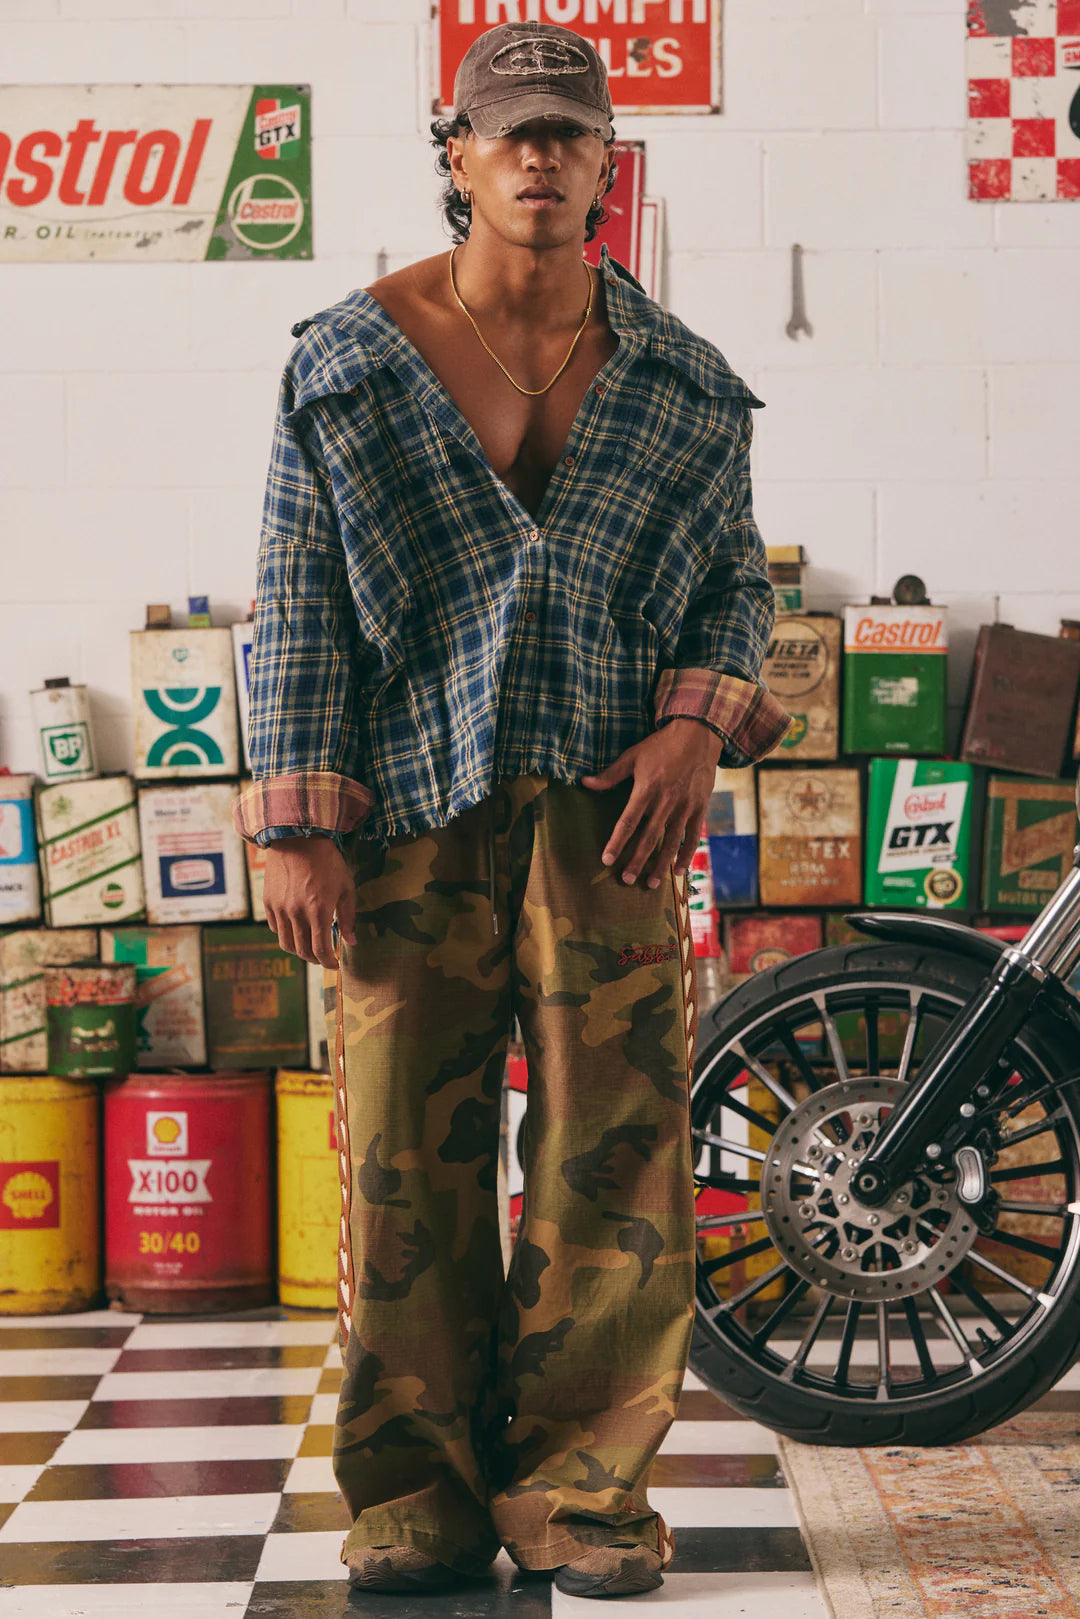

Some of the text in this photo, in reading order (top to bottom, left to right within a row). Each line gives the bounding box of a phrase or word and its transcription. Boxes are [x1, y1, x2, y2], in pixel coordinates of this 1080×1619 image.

[586, 37, 683, 78] LES
[259, 124, 295, 147] GTX
[0, 119, 213, 207] strol
[240, 202, 298, 220] Castrol
[36, 225, 75, 240] OIL
[854, 617, 942, 645] Castrol
[53, 737, 81, 760] BP
[888, 821, 955, 849] GTX
[133, 1206, 204, 1216] MOTOR OIL
[139, 1231, 200, 1254] 30/40
